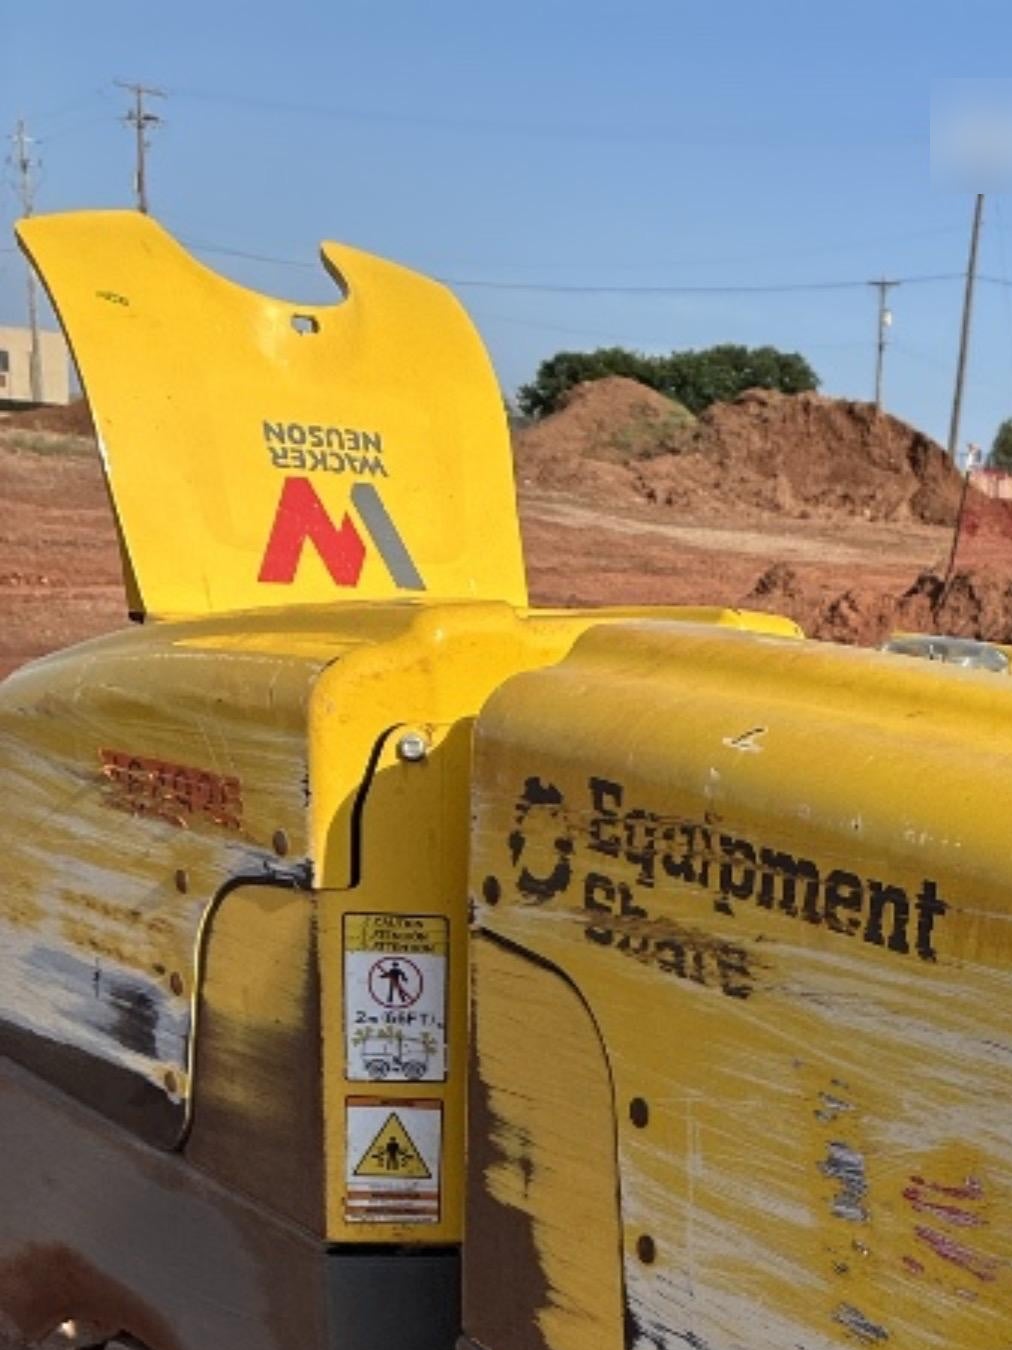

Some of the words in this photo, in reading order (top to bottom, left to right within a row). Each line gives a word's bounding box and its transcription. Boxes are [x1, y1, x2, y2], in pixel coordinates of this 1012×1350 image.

[263, 420, 382, 453] NEUSON
[269, 447, 389, 478] WACKER
[587, 776, 951, 963] Equipment
